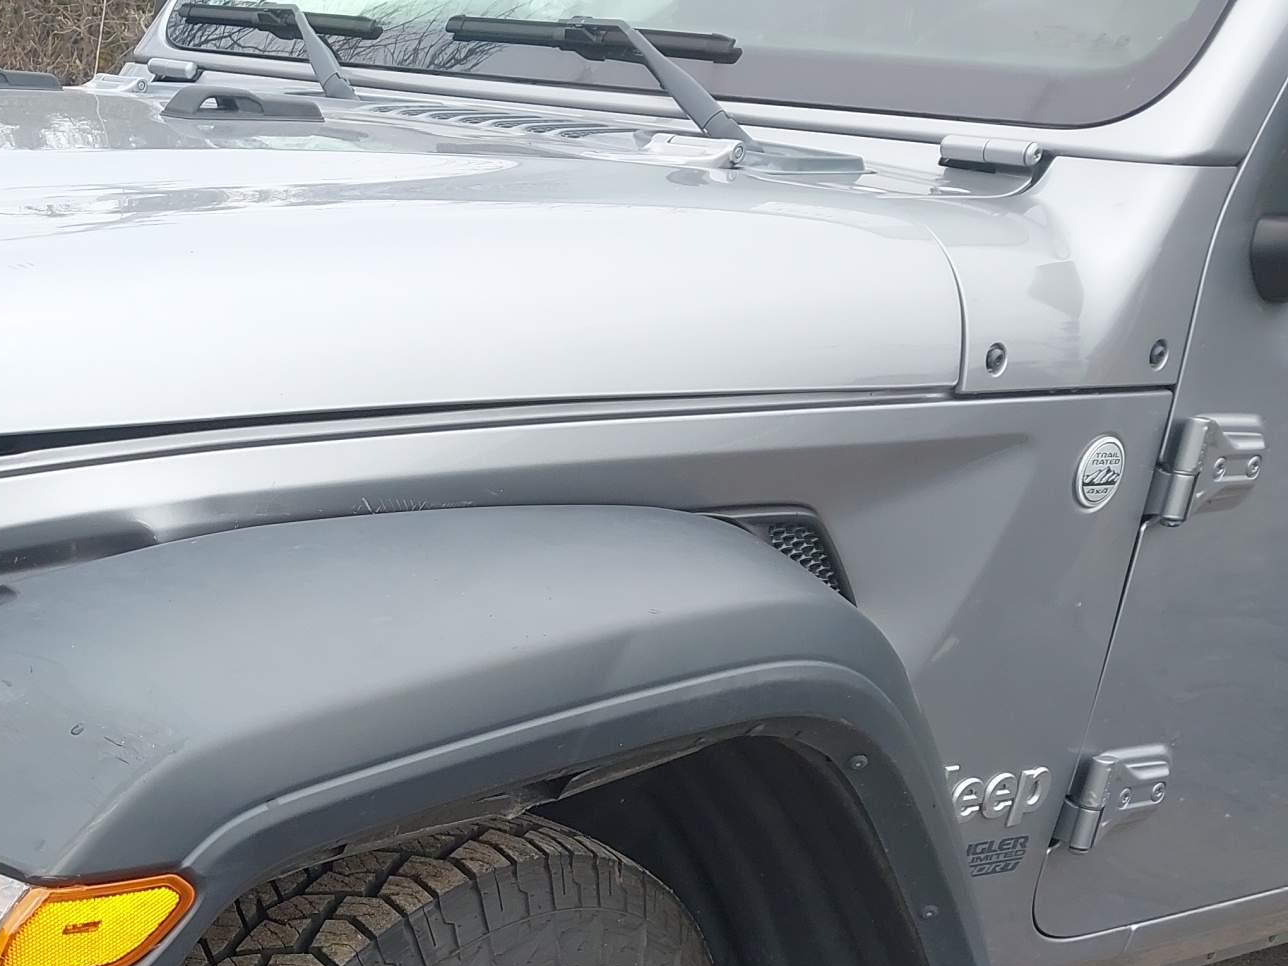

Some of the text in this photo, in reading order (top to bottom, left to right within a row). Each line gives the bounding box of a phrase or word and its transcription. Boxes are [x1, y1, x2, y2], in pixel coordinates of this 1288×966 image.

[1095, 451, 1120, 459] TRAIL
[1091, 458, 1121, 466] RATED
[966, 835, 1029, 857] GLER
